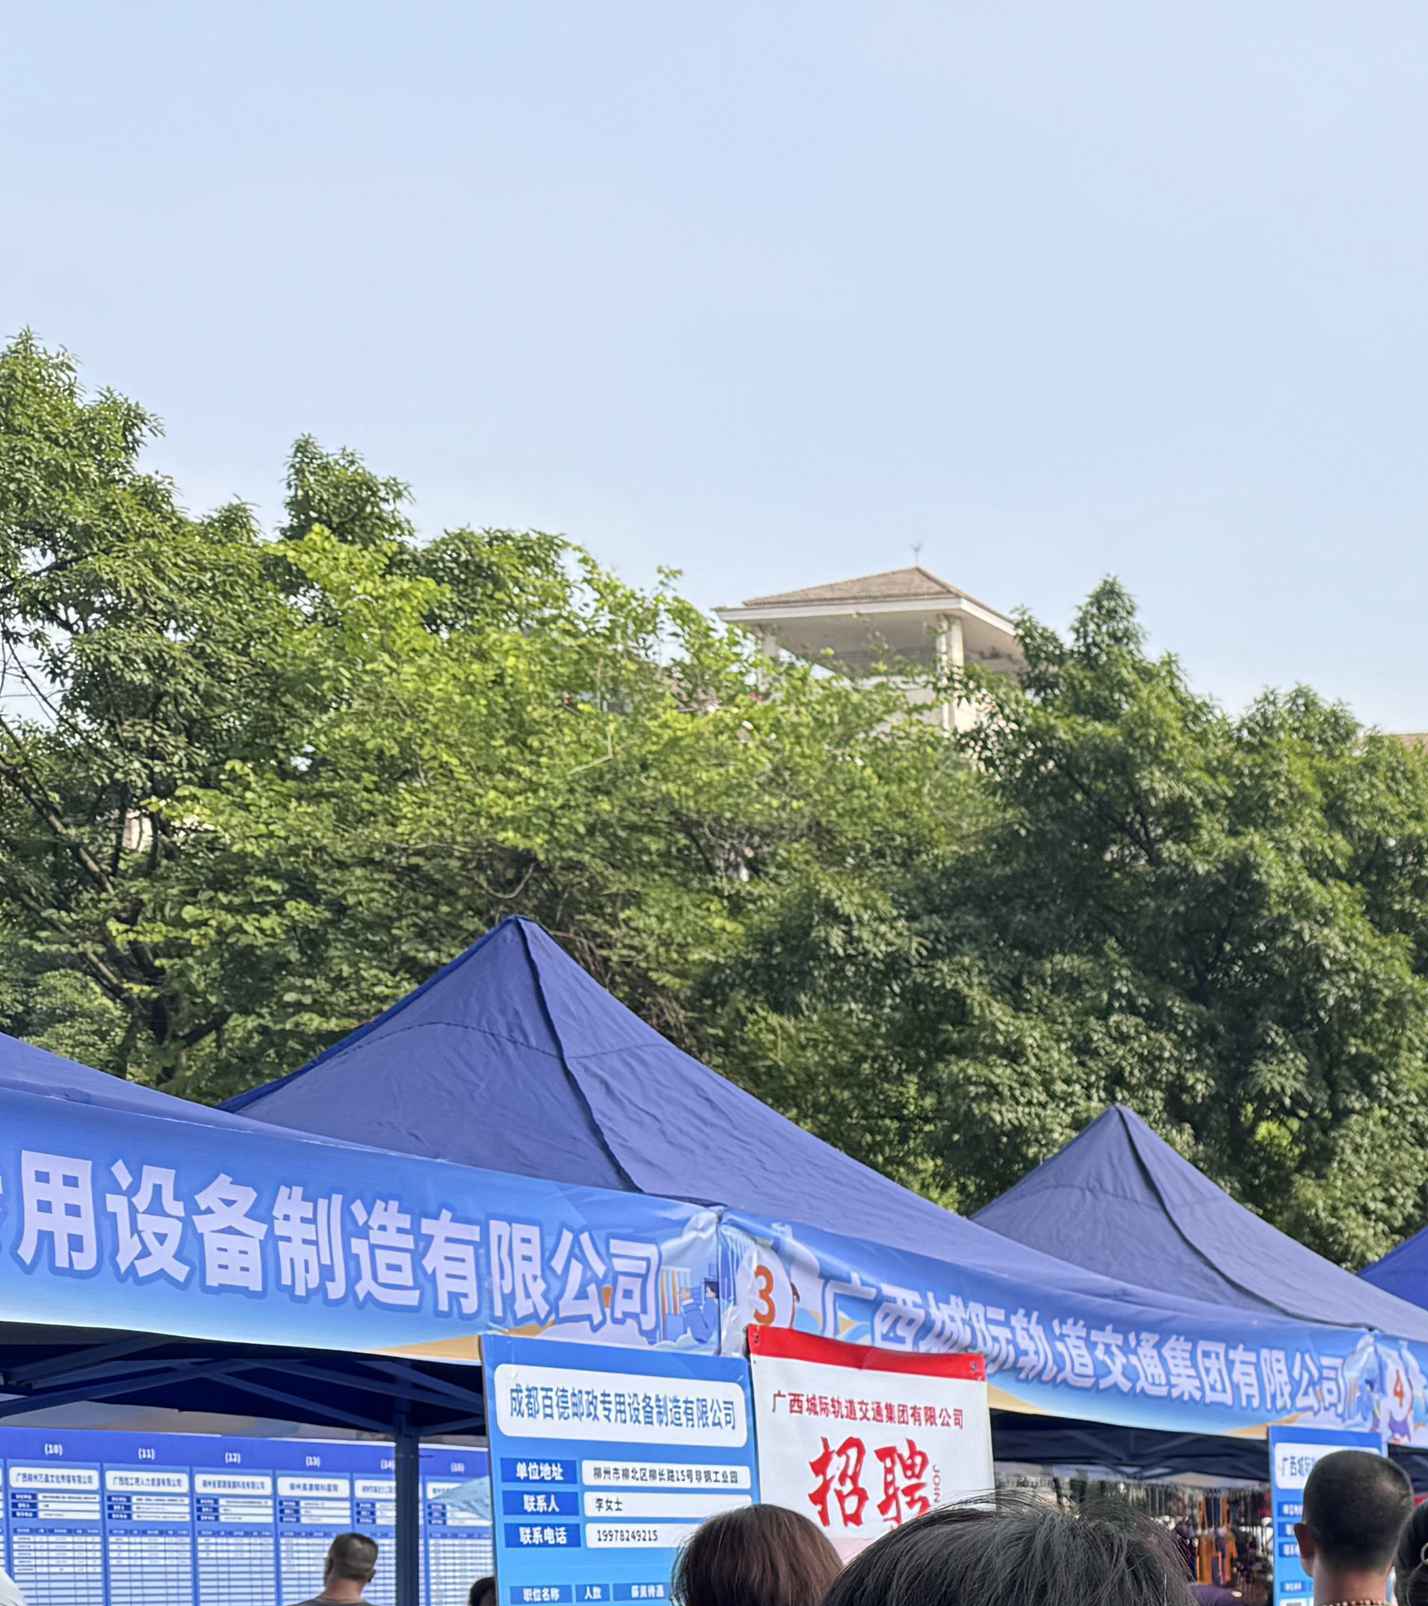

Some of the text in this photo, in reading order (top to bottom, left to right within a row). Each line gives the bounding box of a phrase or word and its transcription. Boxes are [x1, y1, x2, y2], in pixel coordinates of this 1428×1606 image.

[0, 1149, 660, 1331] 用设备制造有限公司
[753, 1265, 776, 1326] 3
[822, 1270, 1347, 1415] 广西城际轨道交通集团有限公司
[509, 1384, 736, 1430] 成都百德邮政专用设备制造有限公司
[772, 1390, 964, 1429] 广西城际轨道交通集团有限公司
[516, 1462, 564, 1481] 单位地址
[808, 1436, 930, 1528] 招聘
[523, 1494, 560, 1513] 联系人
[519, 1527, 568, 1546] 联系电话
